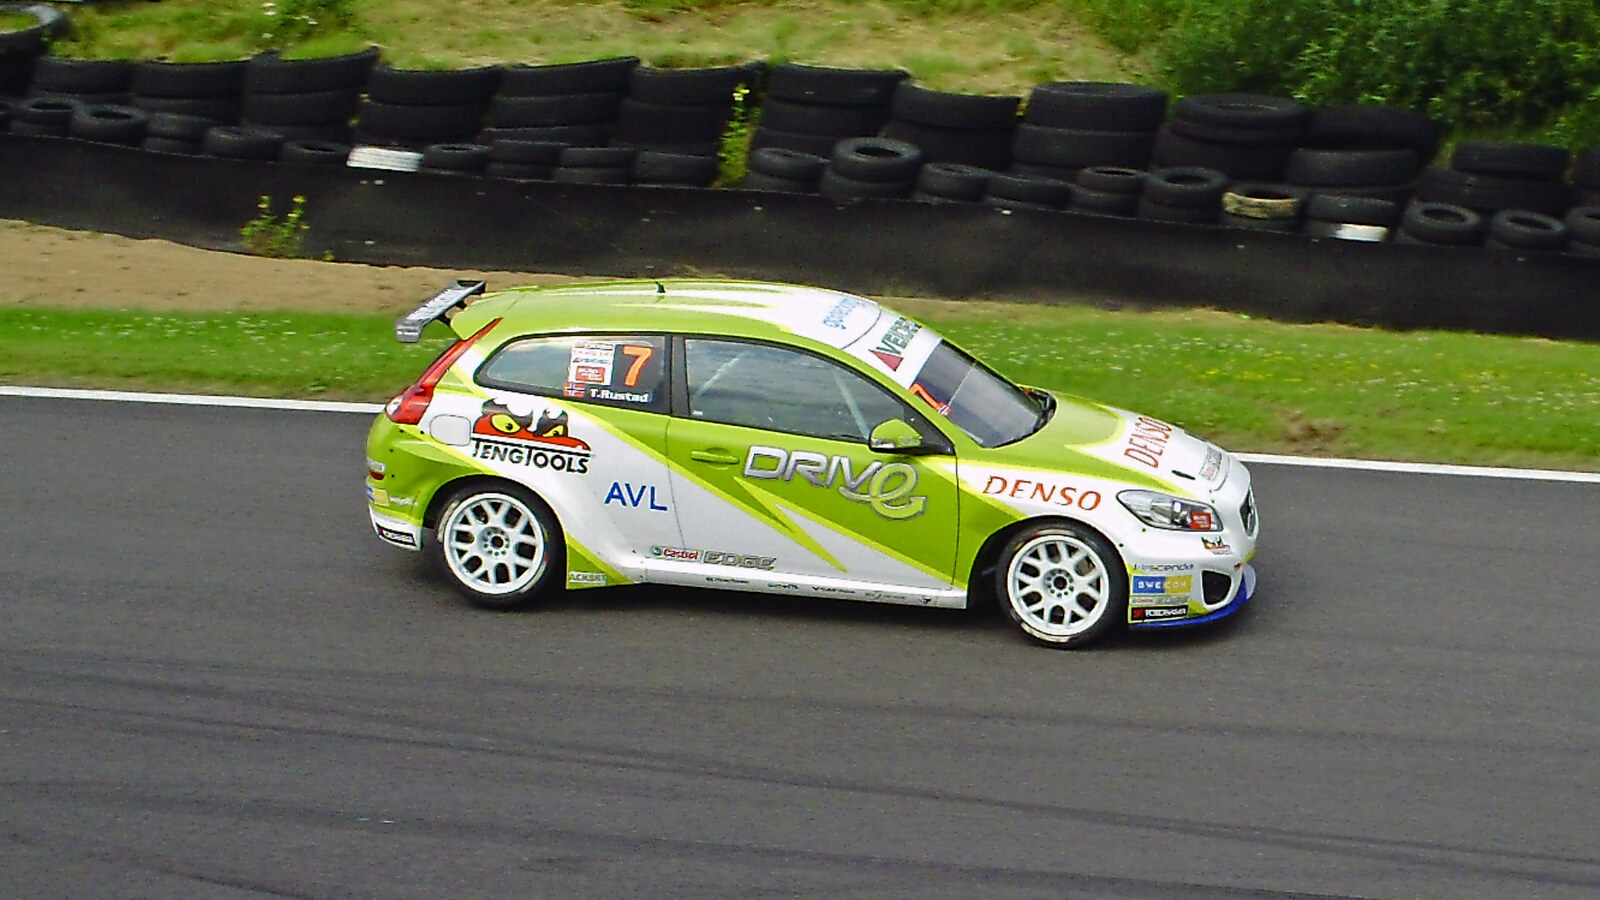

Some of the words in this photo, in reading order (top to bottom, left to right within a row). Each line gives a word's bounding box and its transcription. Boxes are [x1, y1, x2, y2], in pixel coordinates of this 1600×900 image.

[623, 344, 653, 387] 7
[1123, 416, 1172, 468] DENSO
[604, 481, 668, 511] AVL
[982, 475, 1101, 511] DENSO
[664, 549, 699, 560] Castrol
[704, 551, 776, 571] EDGE
